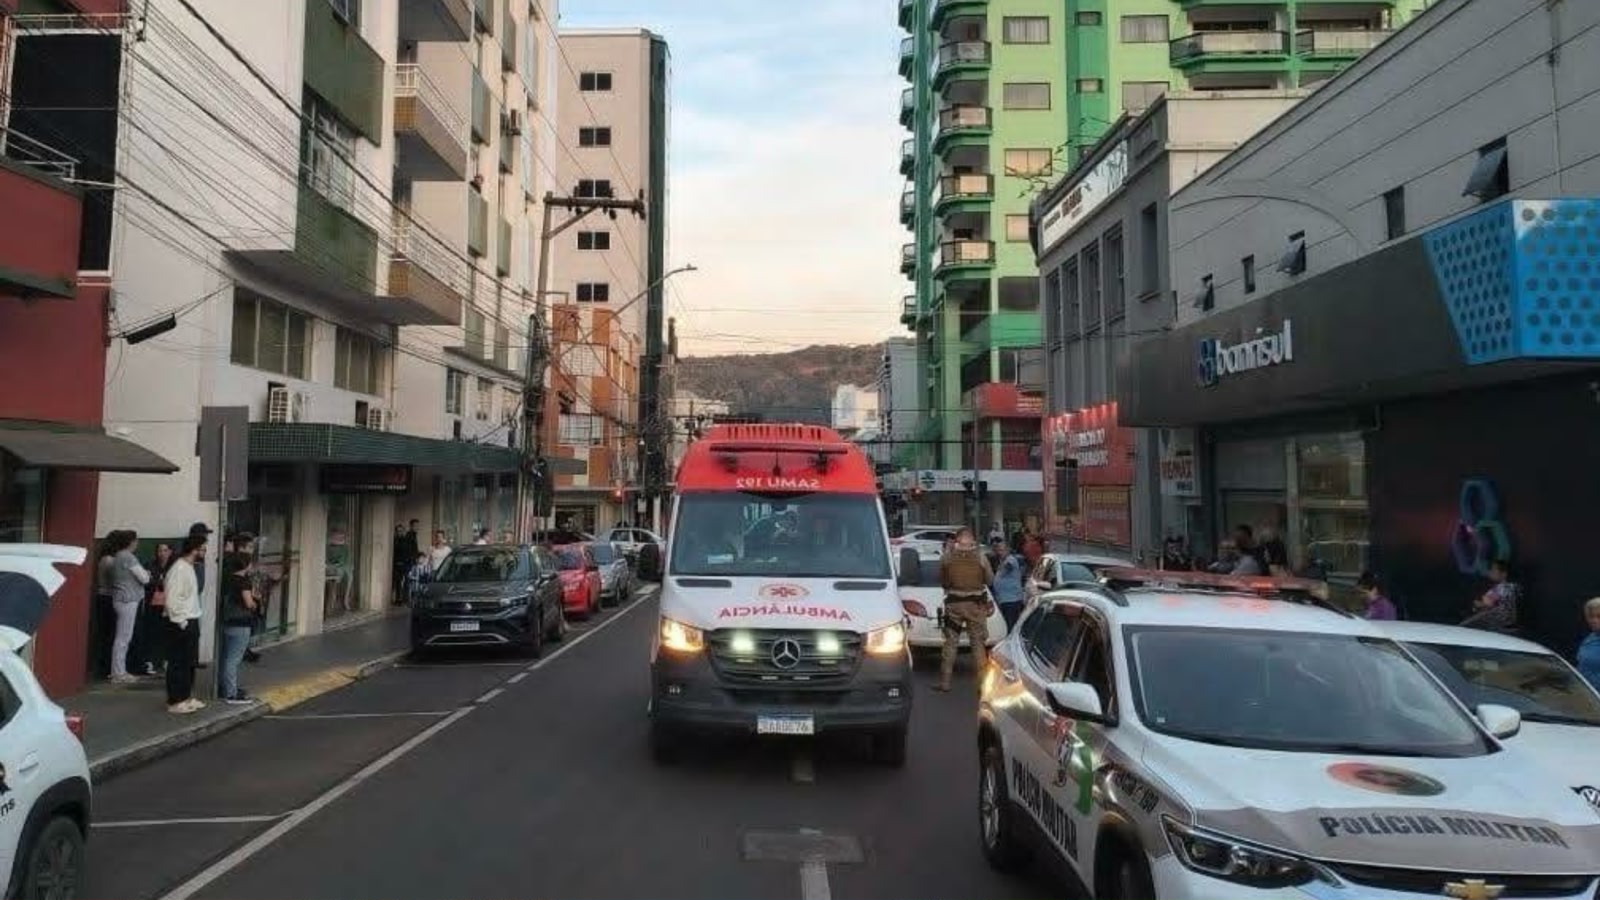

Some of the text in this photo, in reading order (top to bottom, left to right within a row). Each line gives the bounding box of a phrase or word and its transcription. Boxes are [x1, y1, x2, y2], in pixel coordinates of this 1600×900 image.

[1215, 319, 1293, 376] banrisul
[1319, 813, 1570, 849] POLÍCIA MILITAR
